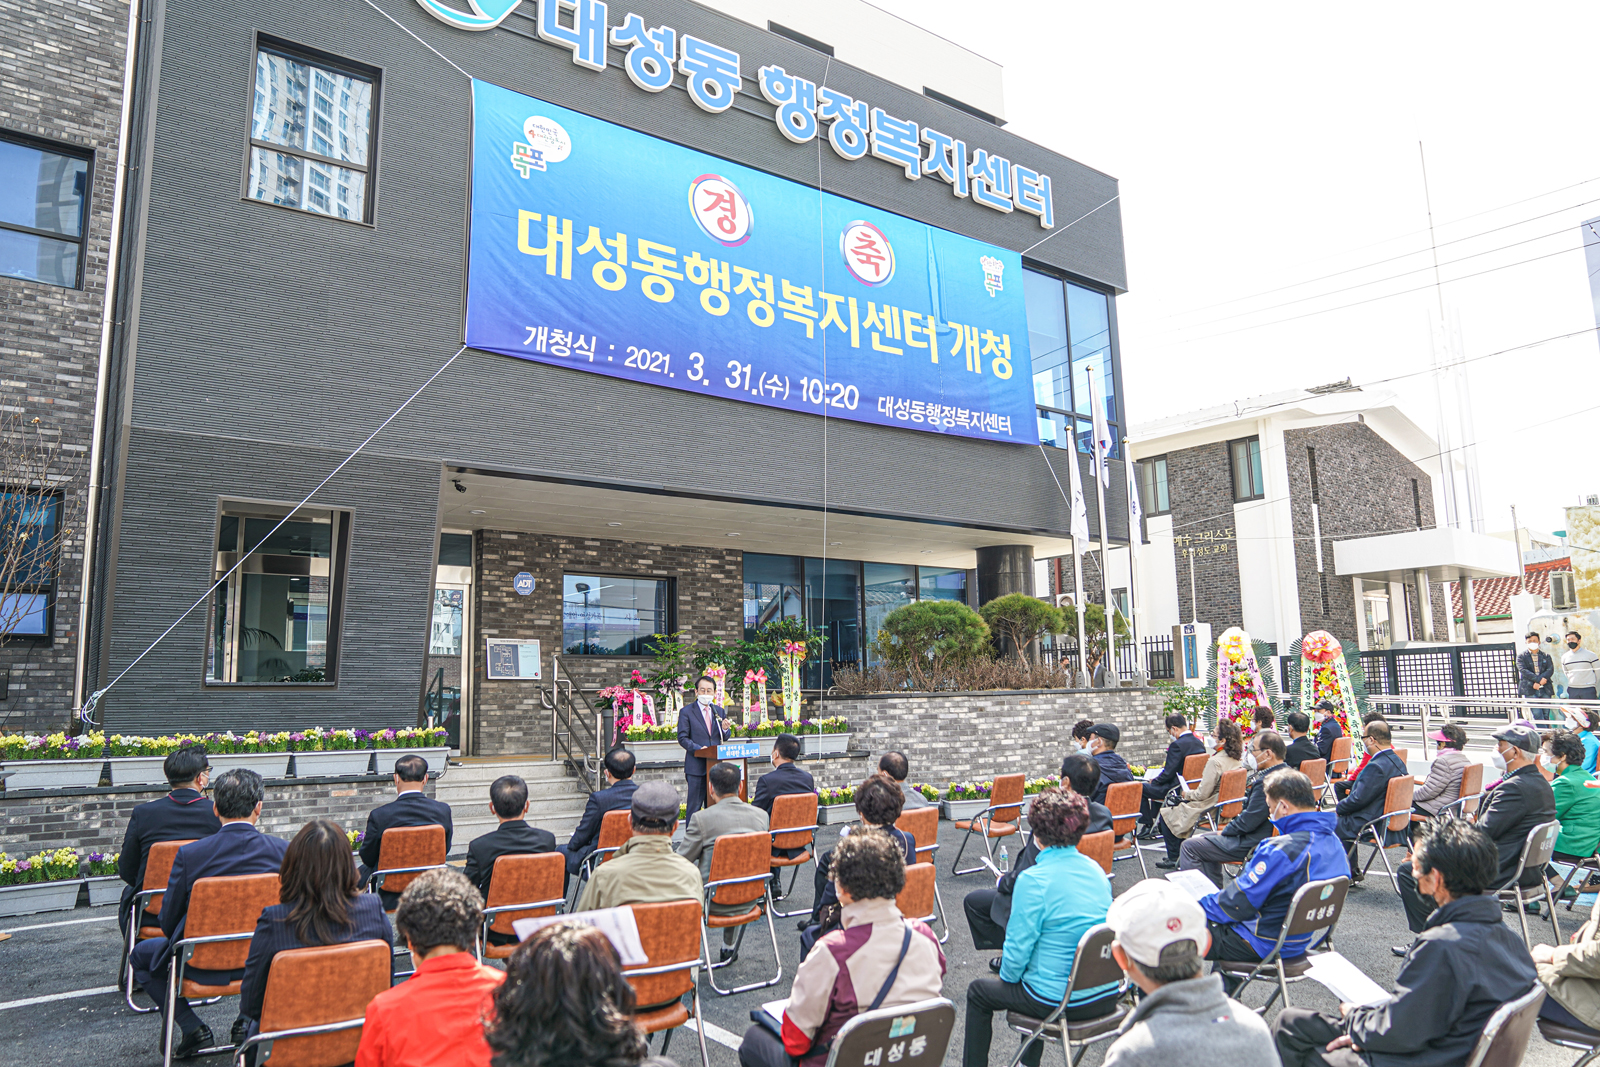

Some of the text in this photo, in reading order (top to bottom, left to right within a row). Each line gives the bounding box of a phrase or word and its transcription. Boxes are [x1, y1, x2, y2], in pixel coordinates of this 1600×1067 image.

[538, 0, 1054, 229] 대성동 행정복지센터
[513, 144, 545, 176] 목포
[703, 189, 886, 277] 경 축
[517, 208, 1012, 380] 대성동행정복지센터 개청
[985, 272, 1002, 296] 목포
[523, 325, 597, 363] 개청식
[624, 345, 675, 378] 2021.
[686, 351, 709, 386] 3.
[800, 376, 860, 411] 10:20
[877, 395, 1013, 436] 대성동행정복지센터
[1173, 533, 1193, 547] 예수
[517, 579, 533, 588] ADT
[725, 749, 740, 757] 위대한
[1306, 904, 1336, 922] 대성동
[863, 1034, 928, 1067] 대성동
